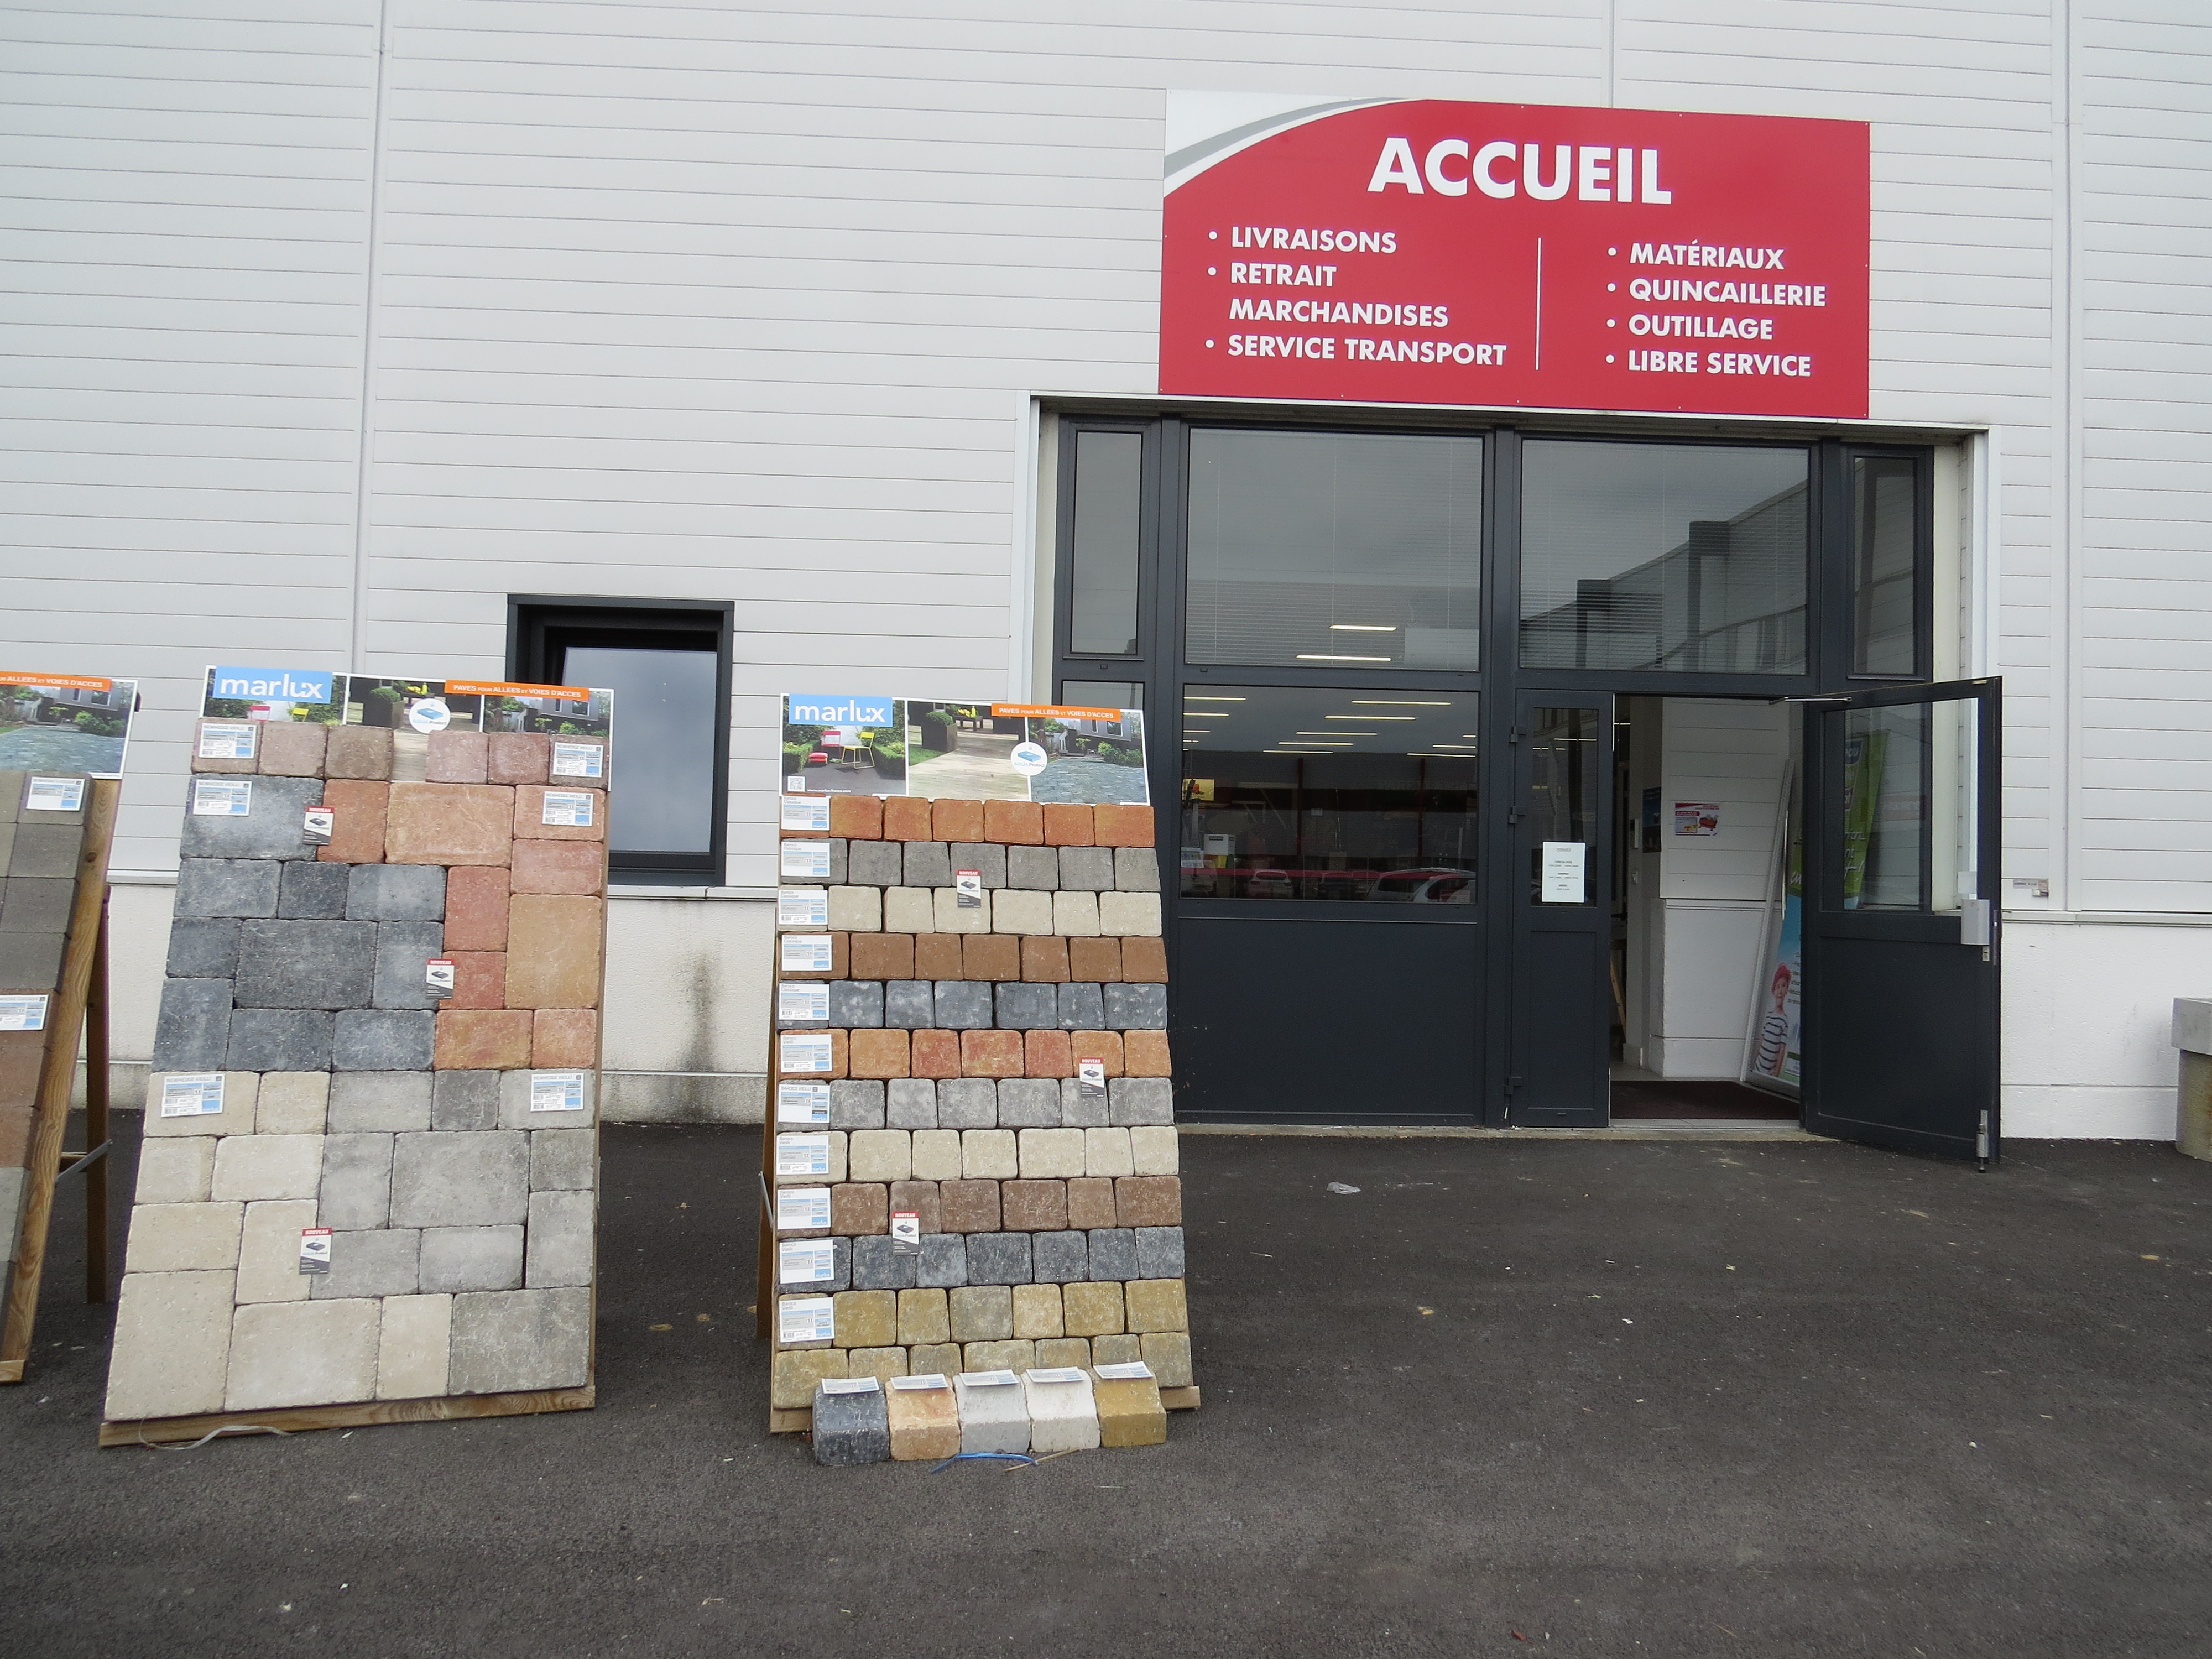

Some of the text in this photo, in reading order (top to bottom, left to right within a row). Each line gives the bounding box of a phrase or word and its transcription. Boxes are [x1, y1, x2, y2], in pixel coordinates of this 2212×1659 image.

[1367, 137, 1671, 204] ACCUEIL
[1232, 226, 1397, 253] LIVRAISONS
[1630, 239, 1785, 270] MATÉRIAUX
[1231, 262, 1337, 286] RETRAIT
[1629, 279, 1825, 306] QUINCAILLERIE
[1229, 299, 1448, 327] MARCHANDISES
[1628, 314, 1772, 340] OUTILLAGE
[1228, 335, 1506, 366] SERVICE TRANSPORT
[1629, 350, 1810, 377] LIBRE SERVICE
[220, 673, 324, 699] marlux
[795, 699, 886, 723] marlux
